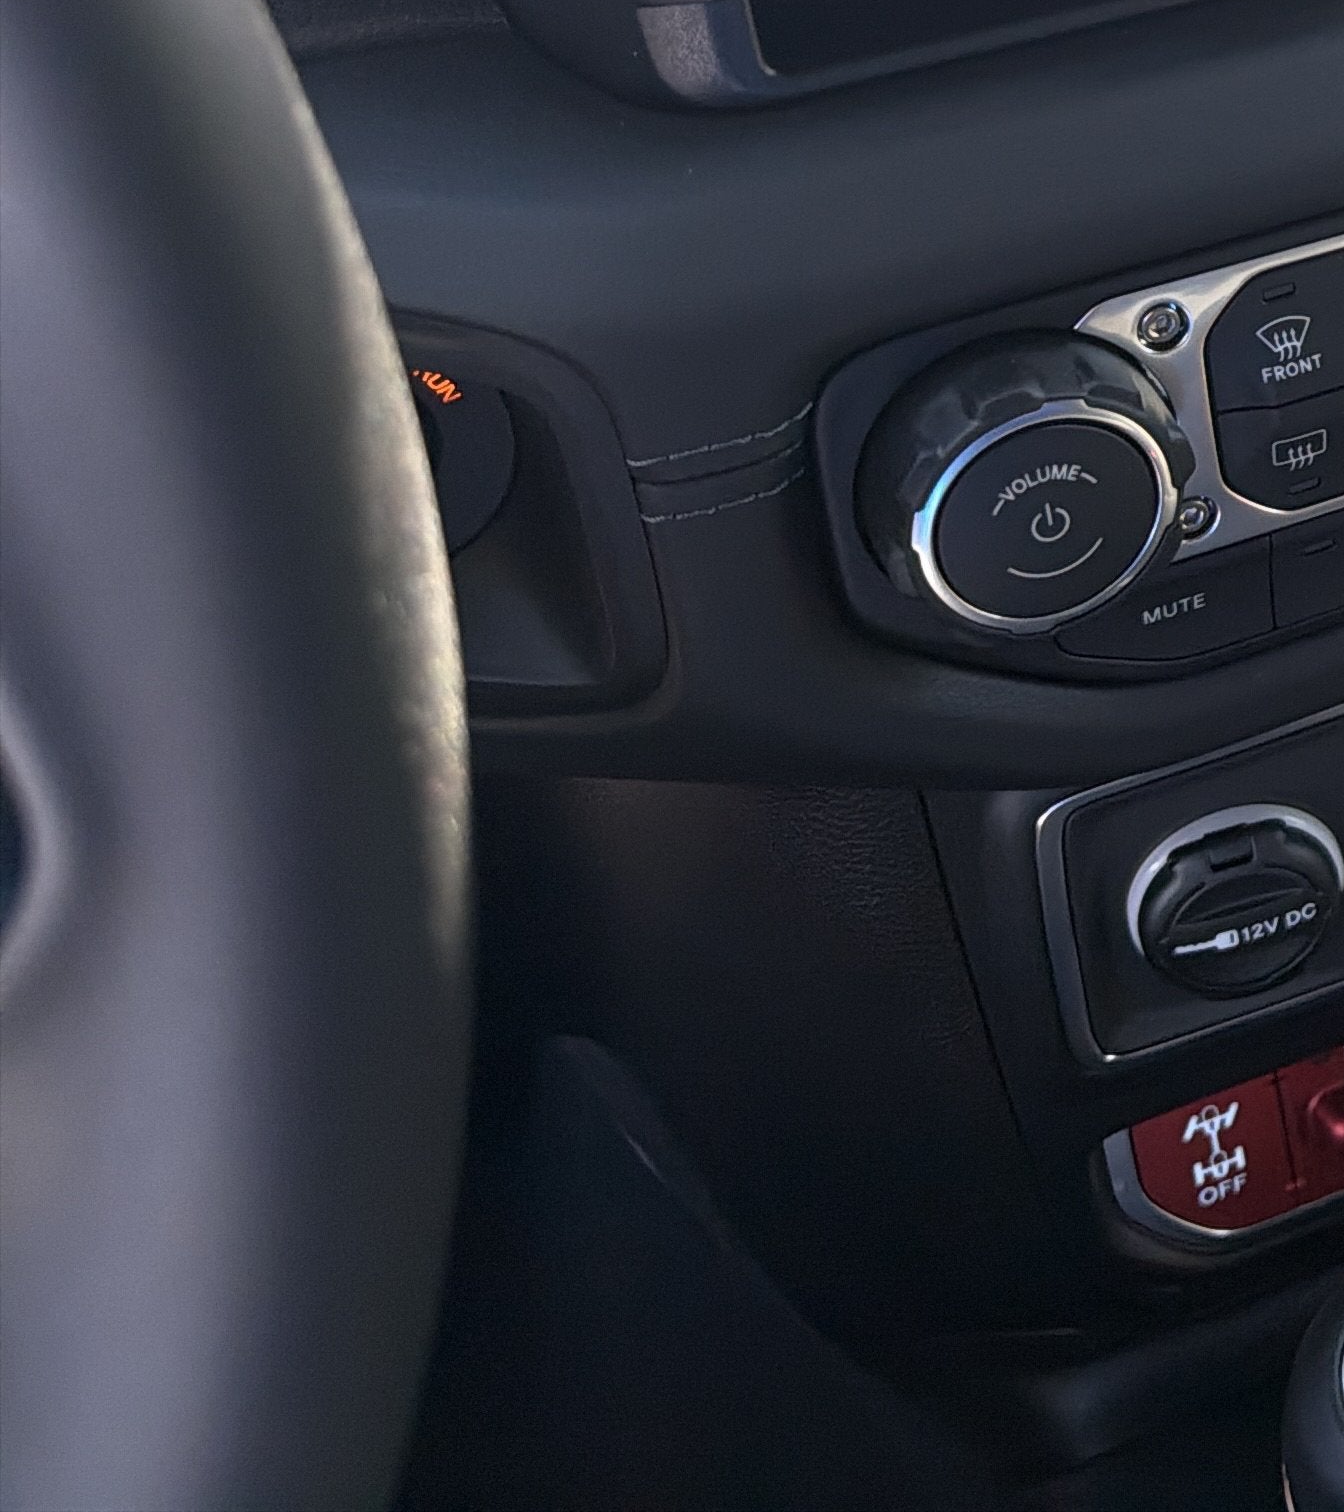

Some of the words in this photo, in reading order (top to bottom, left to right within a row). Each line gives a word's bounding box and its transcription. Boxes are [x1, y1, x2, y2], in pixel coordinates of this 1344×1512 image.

[1261, 353, 1323, 384] FRONT
[1000, 462, 1083, 504] VOLUME
[1142, 592, 1207, 626] MUTE
[1240, 913, 1281, 943] 12V
[1284, 901, 1318, 929] DC
[1198, 1171, 1248, 1207] OFF
